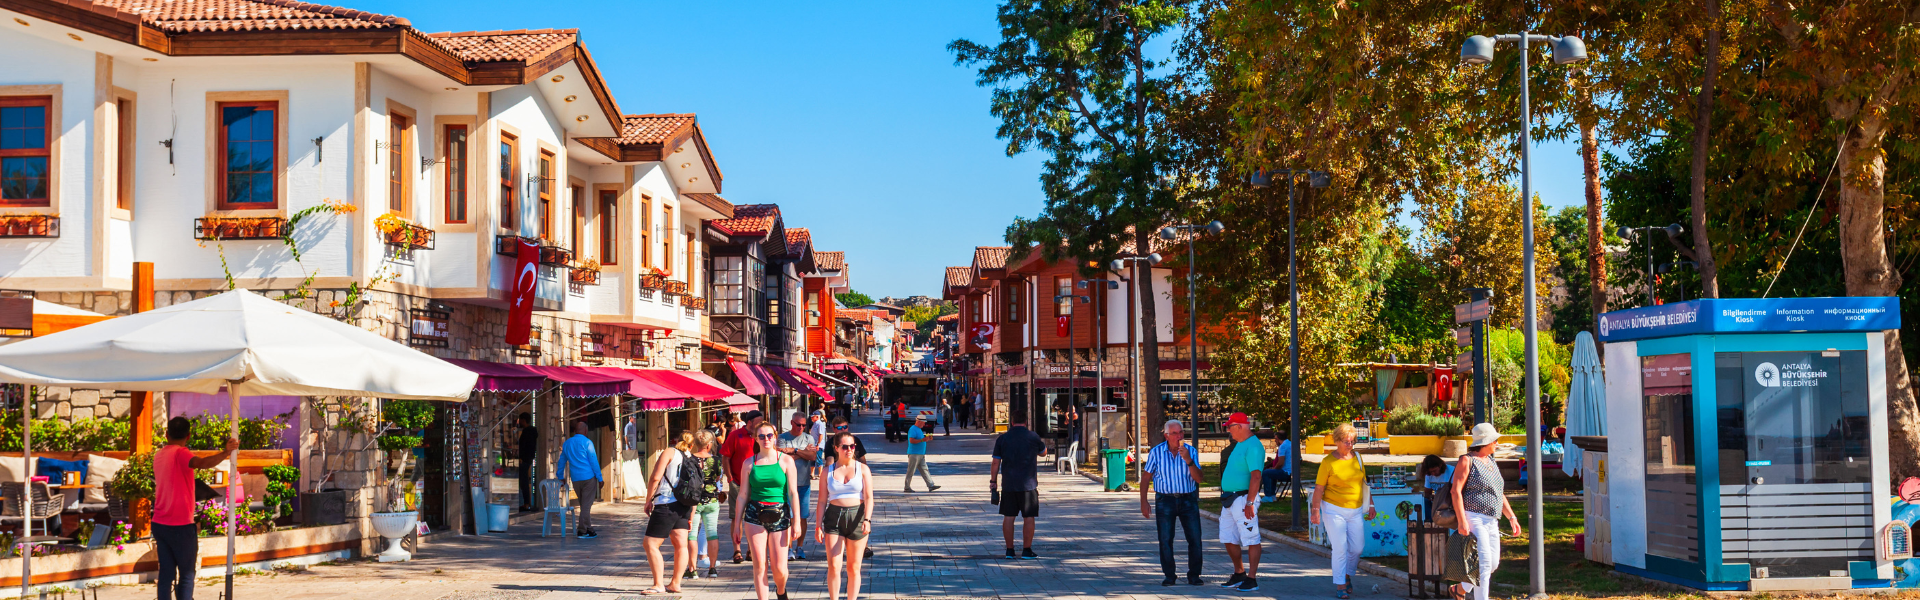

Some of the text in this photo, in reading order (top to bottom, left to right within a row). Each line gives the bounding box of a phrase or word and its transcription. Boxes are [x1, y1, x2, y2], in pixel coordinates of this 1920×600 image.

[1722, 308, 1766, 318] Bilgilendirme
[1824, 307, 1886, 315] информационный
[1609, 308, 1697, 330] ANTALYA BÜYÜKŞEHİR BELEDİYESİ
[1735, 315, 1754, 323] Kiosk
[1782, 369, 1828, 379] BÜYÜKŞEHİR
[1782, 379, 1818, 387] BELEDİYESİ
